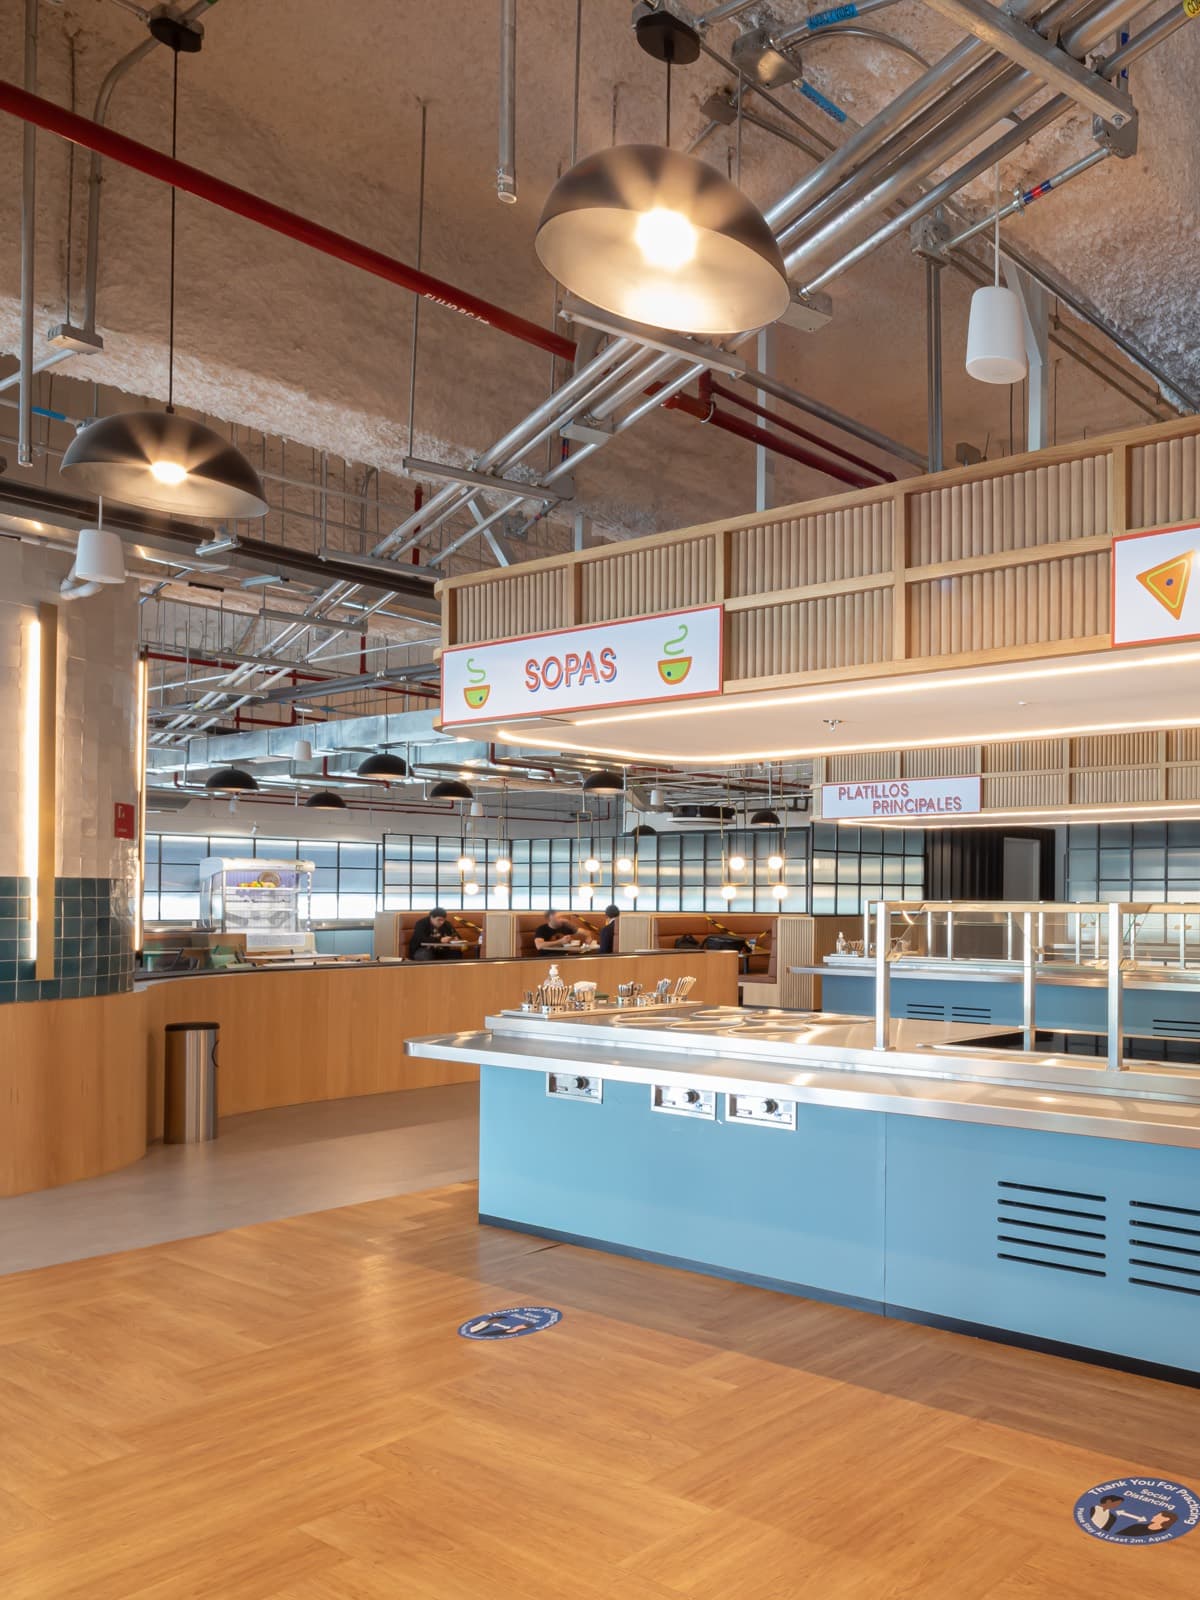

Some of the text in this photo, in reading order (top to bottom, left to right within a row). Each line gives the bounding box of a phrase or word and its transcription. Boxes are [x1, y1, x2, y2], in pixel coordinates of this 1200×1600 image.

[524, 647, 618, 692] SOPAS
[838, 783, 910, 800] PLATILLOS
[872, 796, 963, 815] PRINCIPALES
[1088, 1480, 1128, 1495] Thank
[1129, 1479, 1155, 1487] You
[1157, 1481, 1178, 1492] For
[1140, 1488, 1172, 1502] Social
[1123, 1490, 1177, 1511] Distancing
[1104, 1534, 1128, 1543] Least
[1148, 1533, 1173, 1543] Apart
